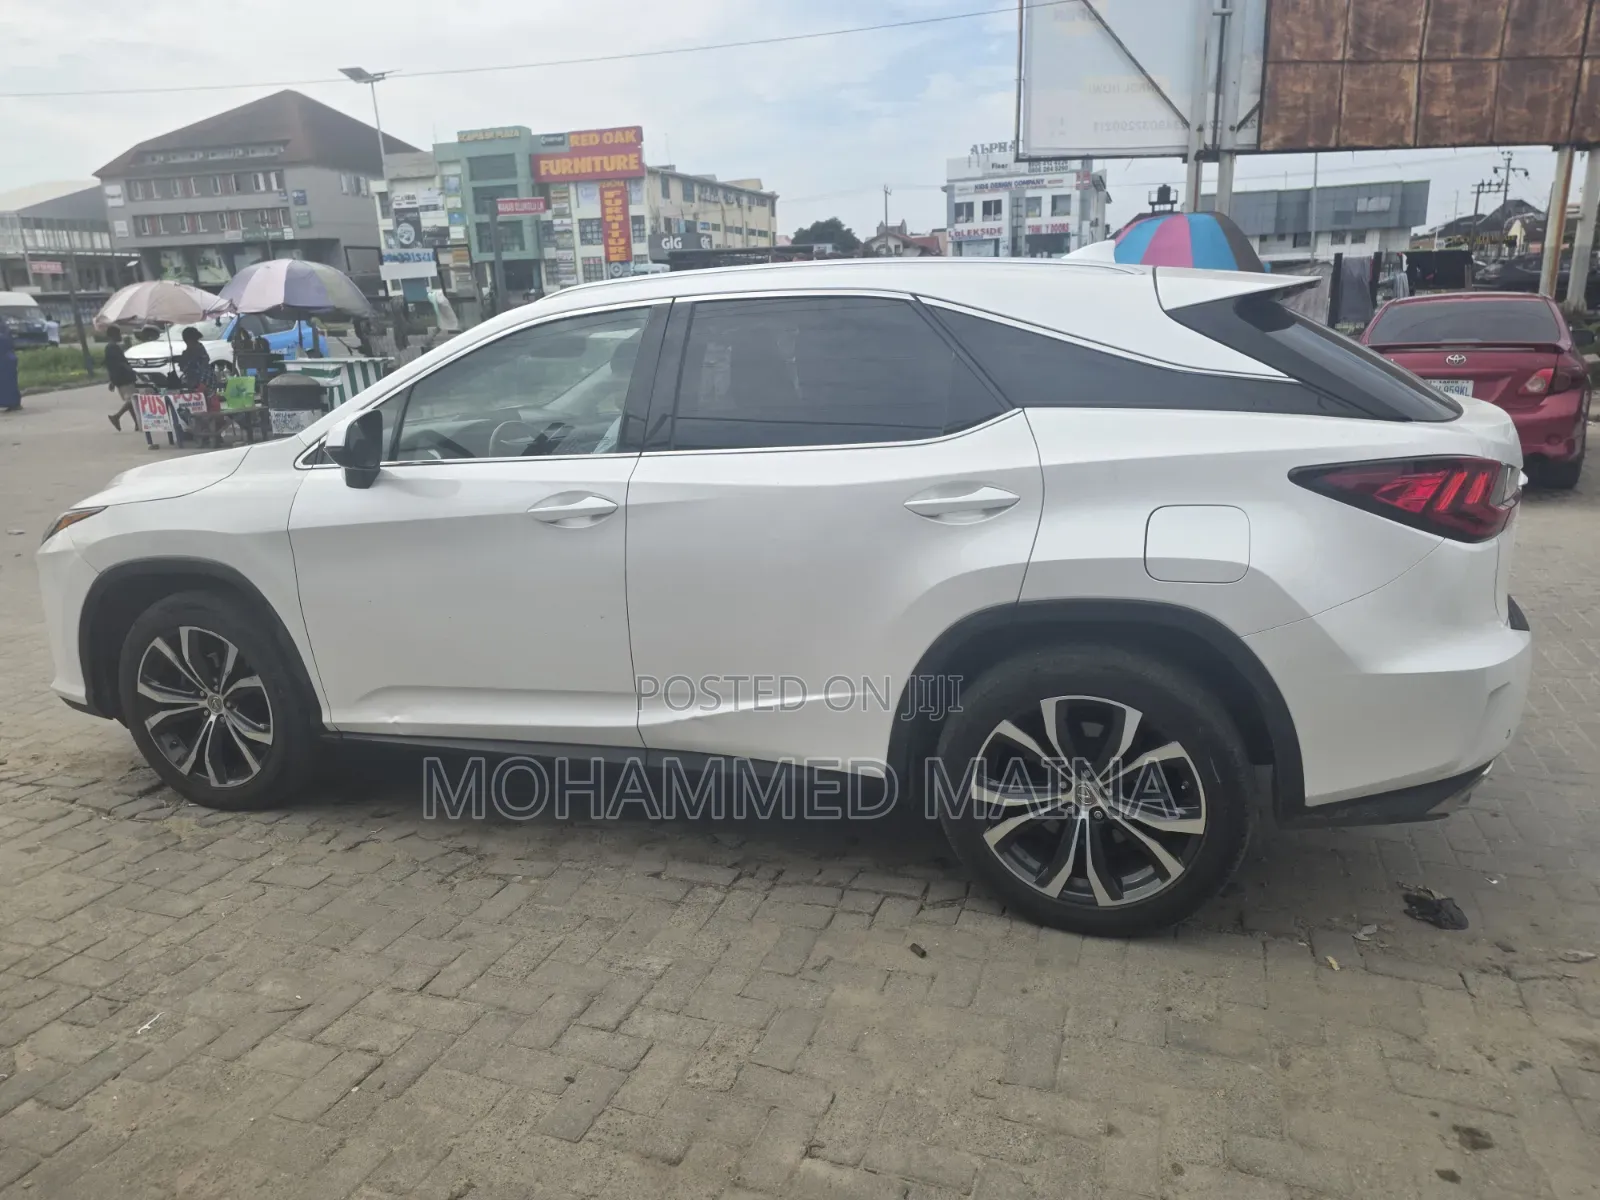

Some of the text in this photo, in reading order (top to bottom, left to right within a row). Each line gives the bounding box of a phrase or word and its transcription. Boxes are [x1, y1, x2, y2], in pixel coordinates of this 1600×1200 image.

[569, 132, 600, 147] RED
[602, 129, 637, 144] OAK
[540, 153, 639, 177] FURNITURE
[1014, 178, 1045, 187] COMPANY
[604, 190, 627, 261] FURNITURE
[661, 235, 682, 250] GIG
[141, 396, 166, 415] POS
